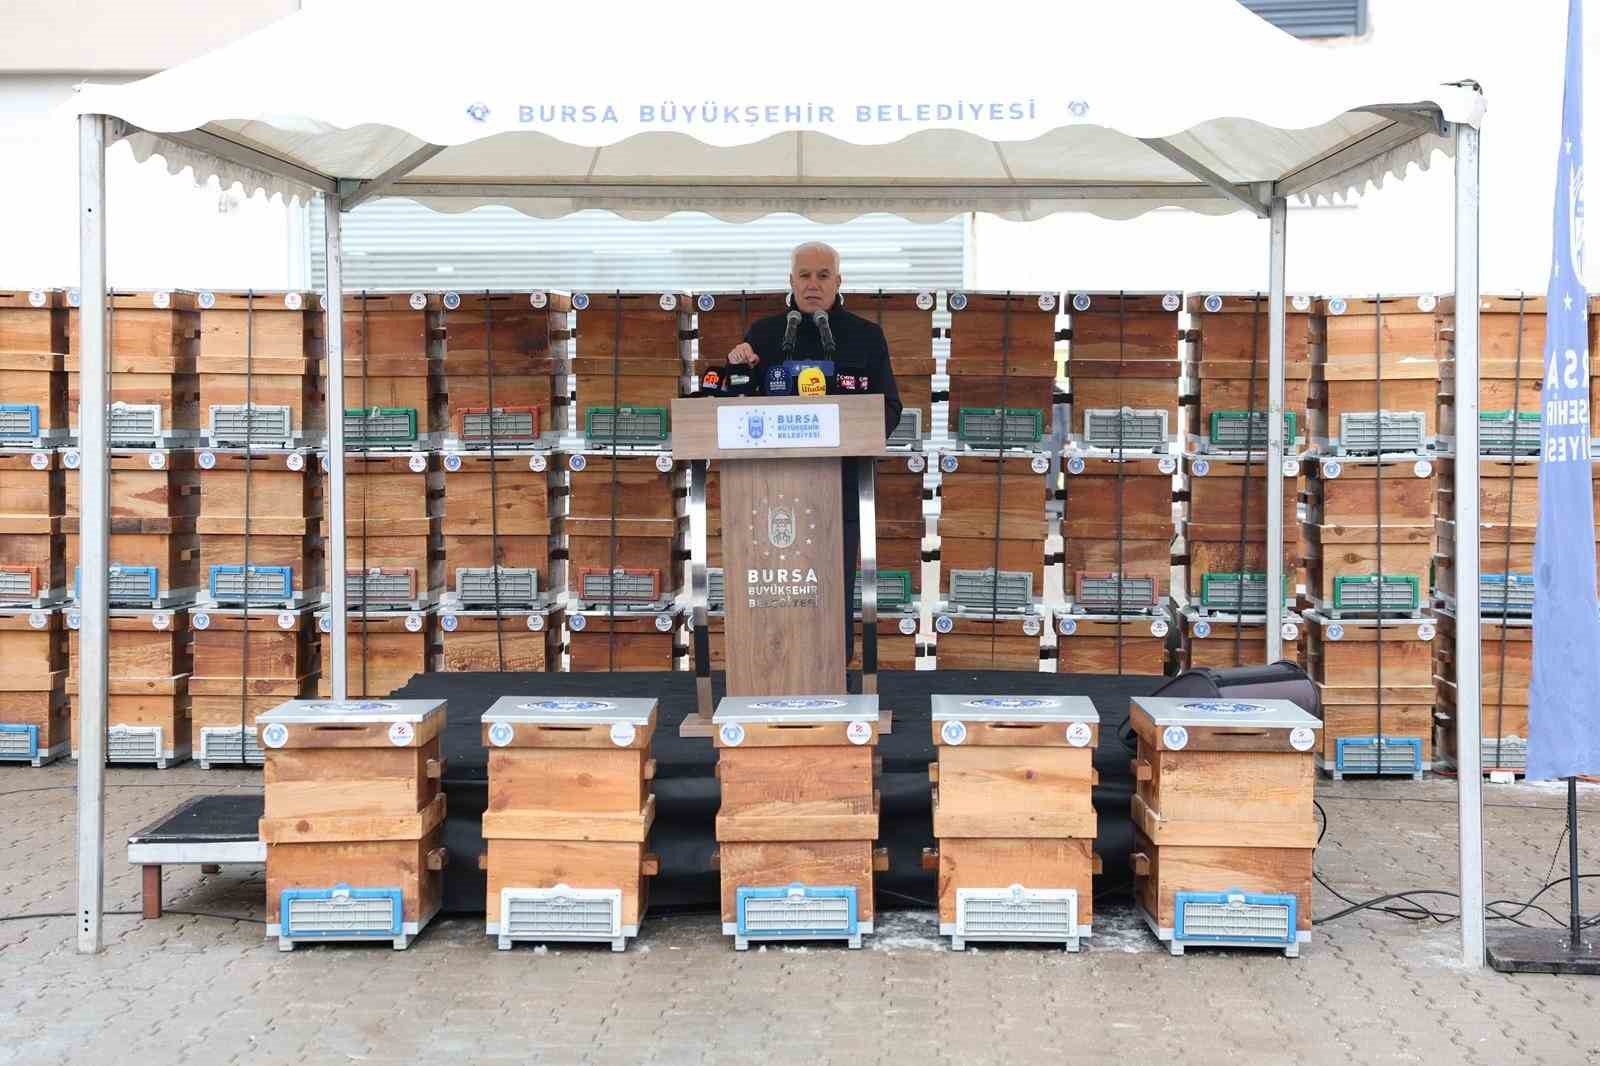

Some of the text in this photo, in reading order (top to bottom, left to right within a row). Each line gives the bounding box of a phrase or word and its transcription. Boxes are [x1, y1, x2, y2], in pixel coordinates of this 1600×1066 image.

[518, 99, 1036, 126] BURSA BÜYÜKŞEHİR BELEDİYESİ
[777, 414, 820, 424] BURSA
[747, 568, 818, 583] BURSA
